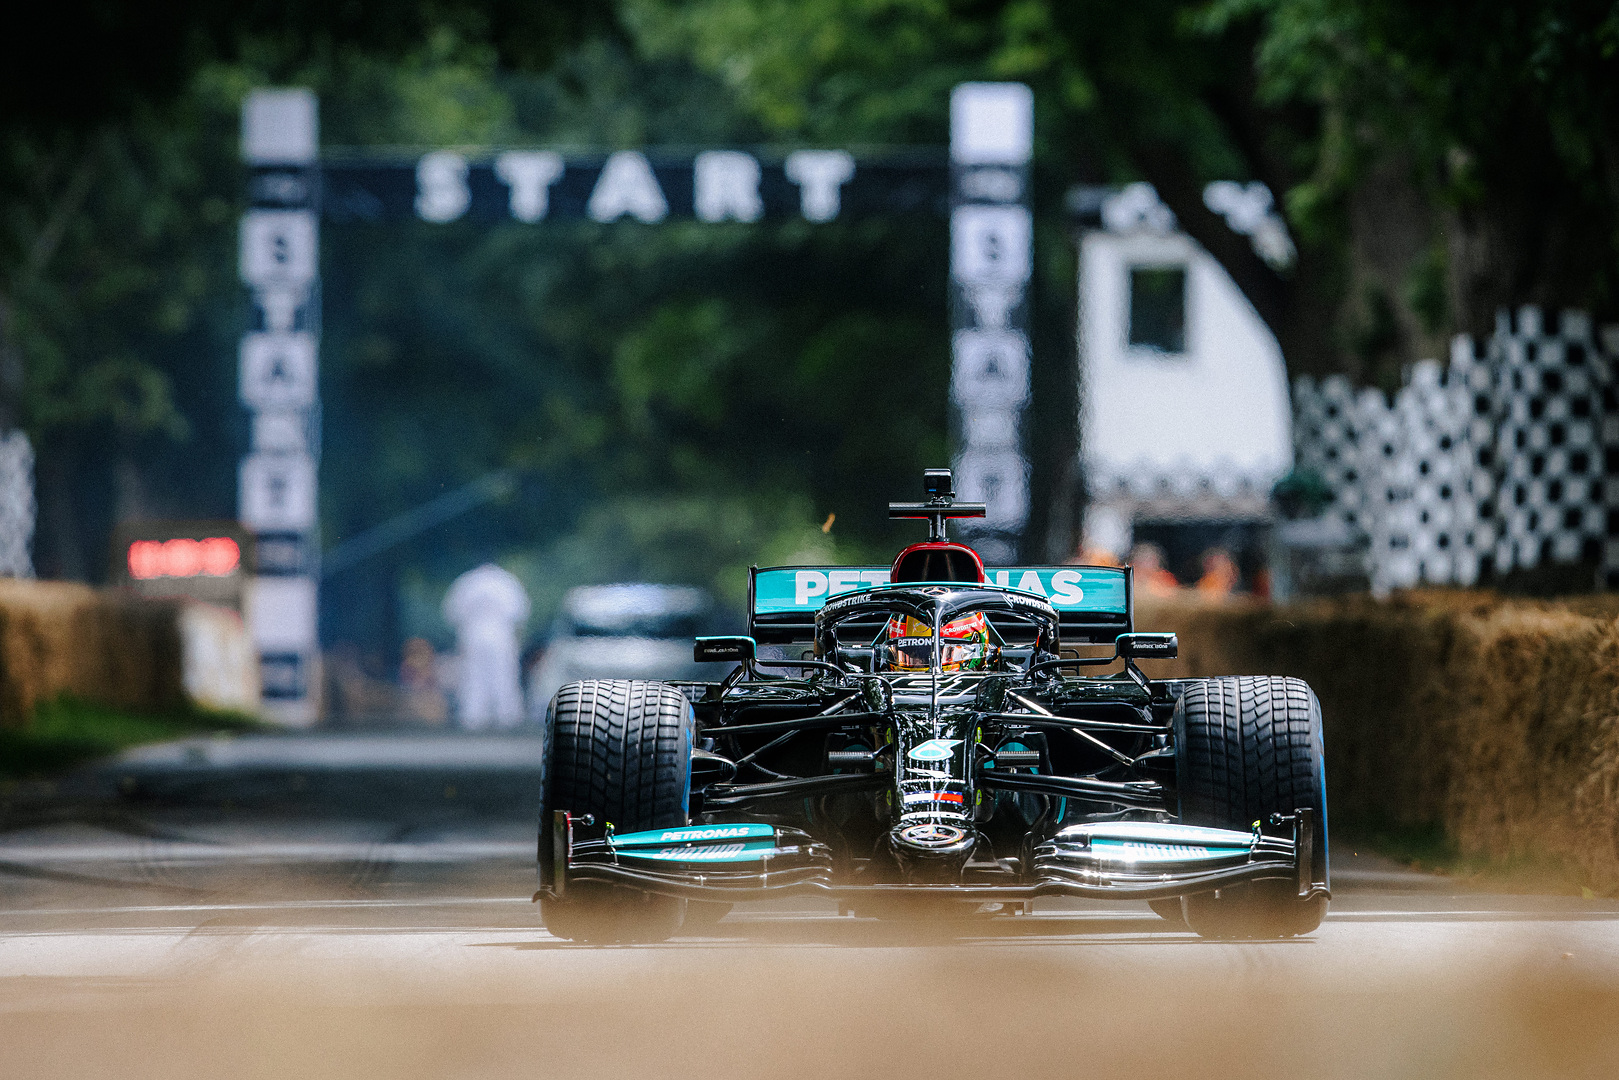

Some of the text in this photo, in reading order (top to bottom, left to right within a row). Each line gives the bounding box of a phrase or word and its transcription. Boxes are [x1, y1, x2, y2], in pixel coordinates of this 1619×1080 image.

[414, 150, 856, 224] START
[795, 569, 1084, 605] PETAS
[897, 637, 945, 648] PETRONS
[660, 827, 750, 841] PETRONAS
